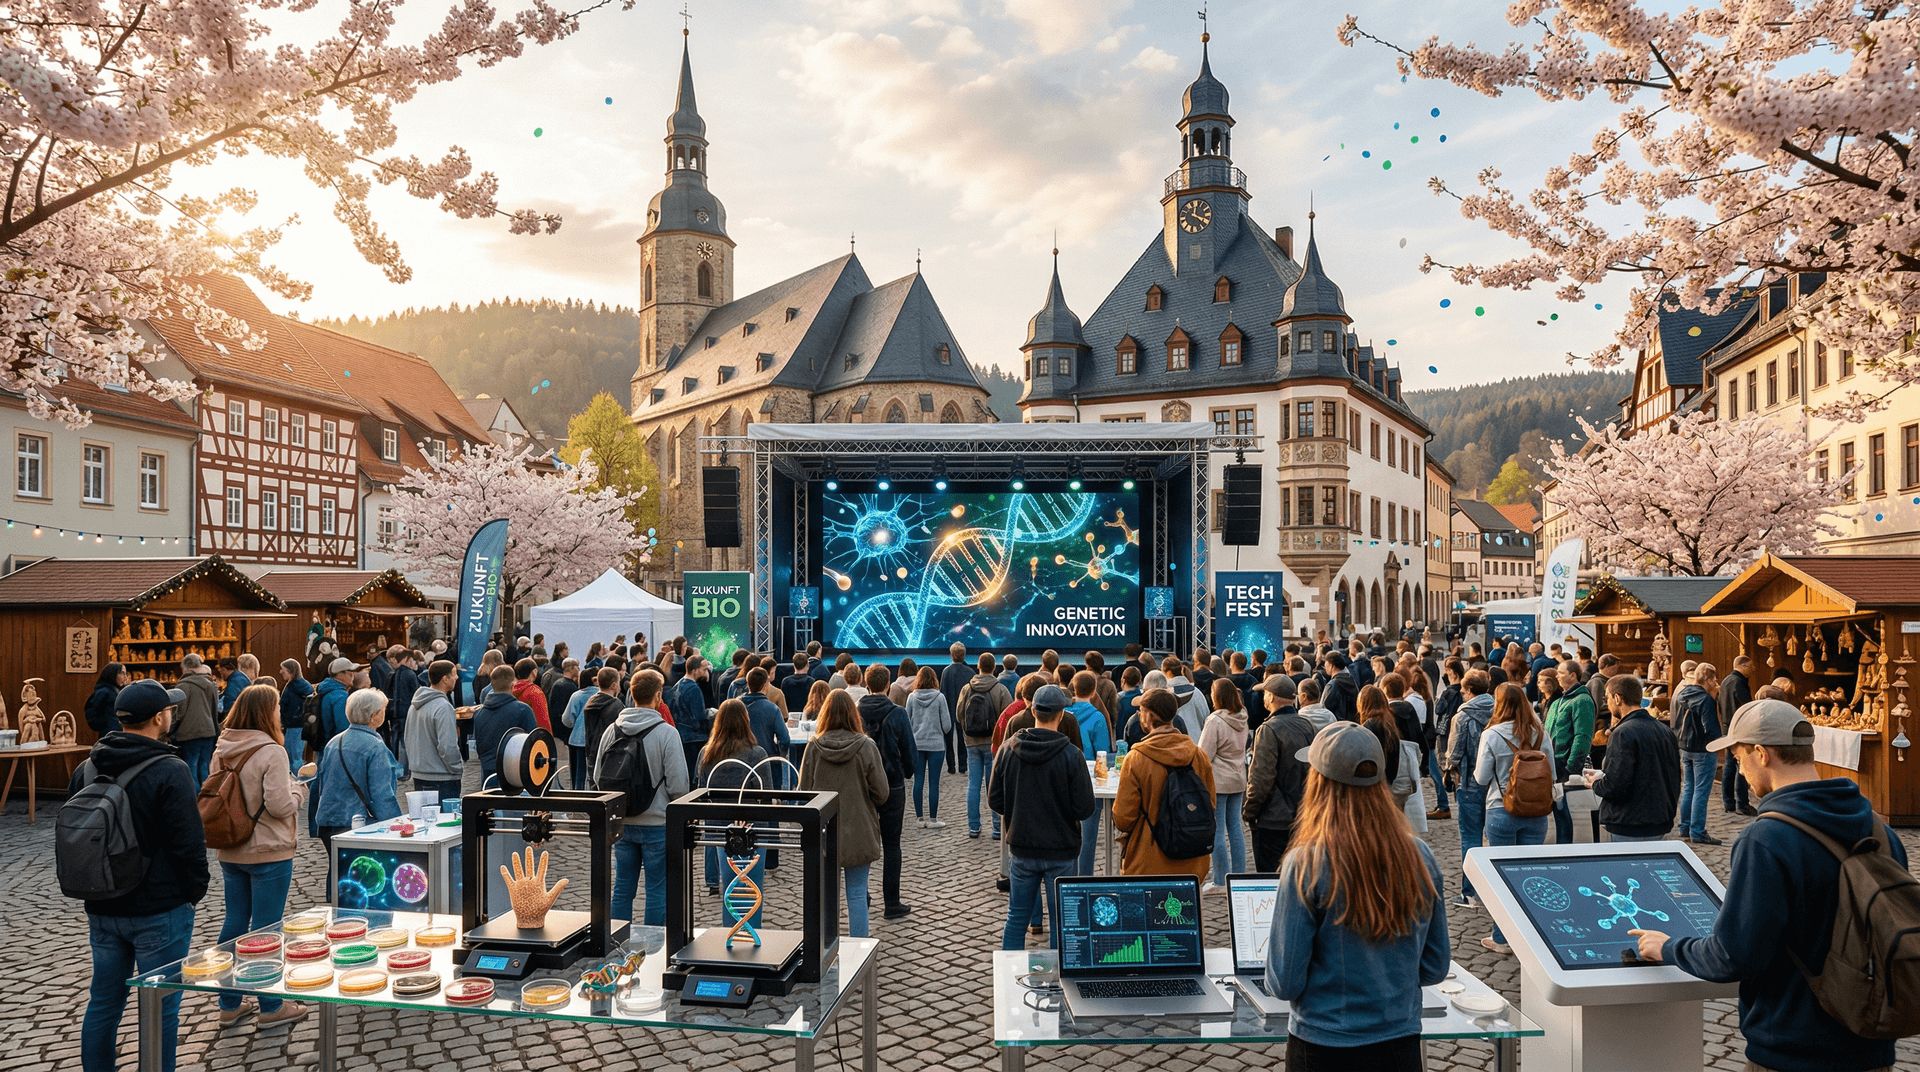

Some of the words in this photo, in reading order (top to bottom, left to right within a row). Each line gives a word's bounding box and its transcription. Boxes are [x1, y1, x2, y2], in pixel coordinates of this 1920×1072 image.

[486, 573, 498, 596] BIO
[691, 585, 741, 595] ZUKUNFT
[469, 552, 489, 633] ZUKUNFT
[1224, 585, 1274, 600] TECH
[692, 597, 741, 618] BIO
[1054, 606, 1126, 620] GENETIC
[1225, 602, 1274, 617] FEST
[1026, 623, 1126, 637] INNOVATION
